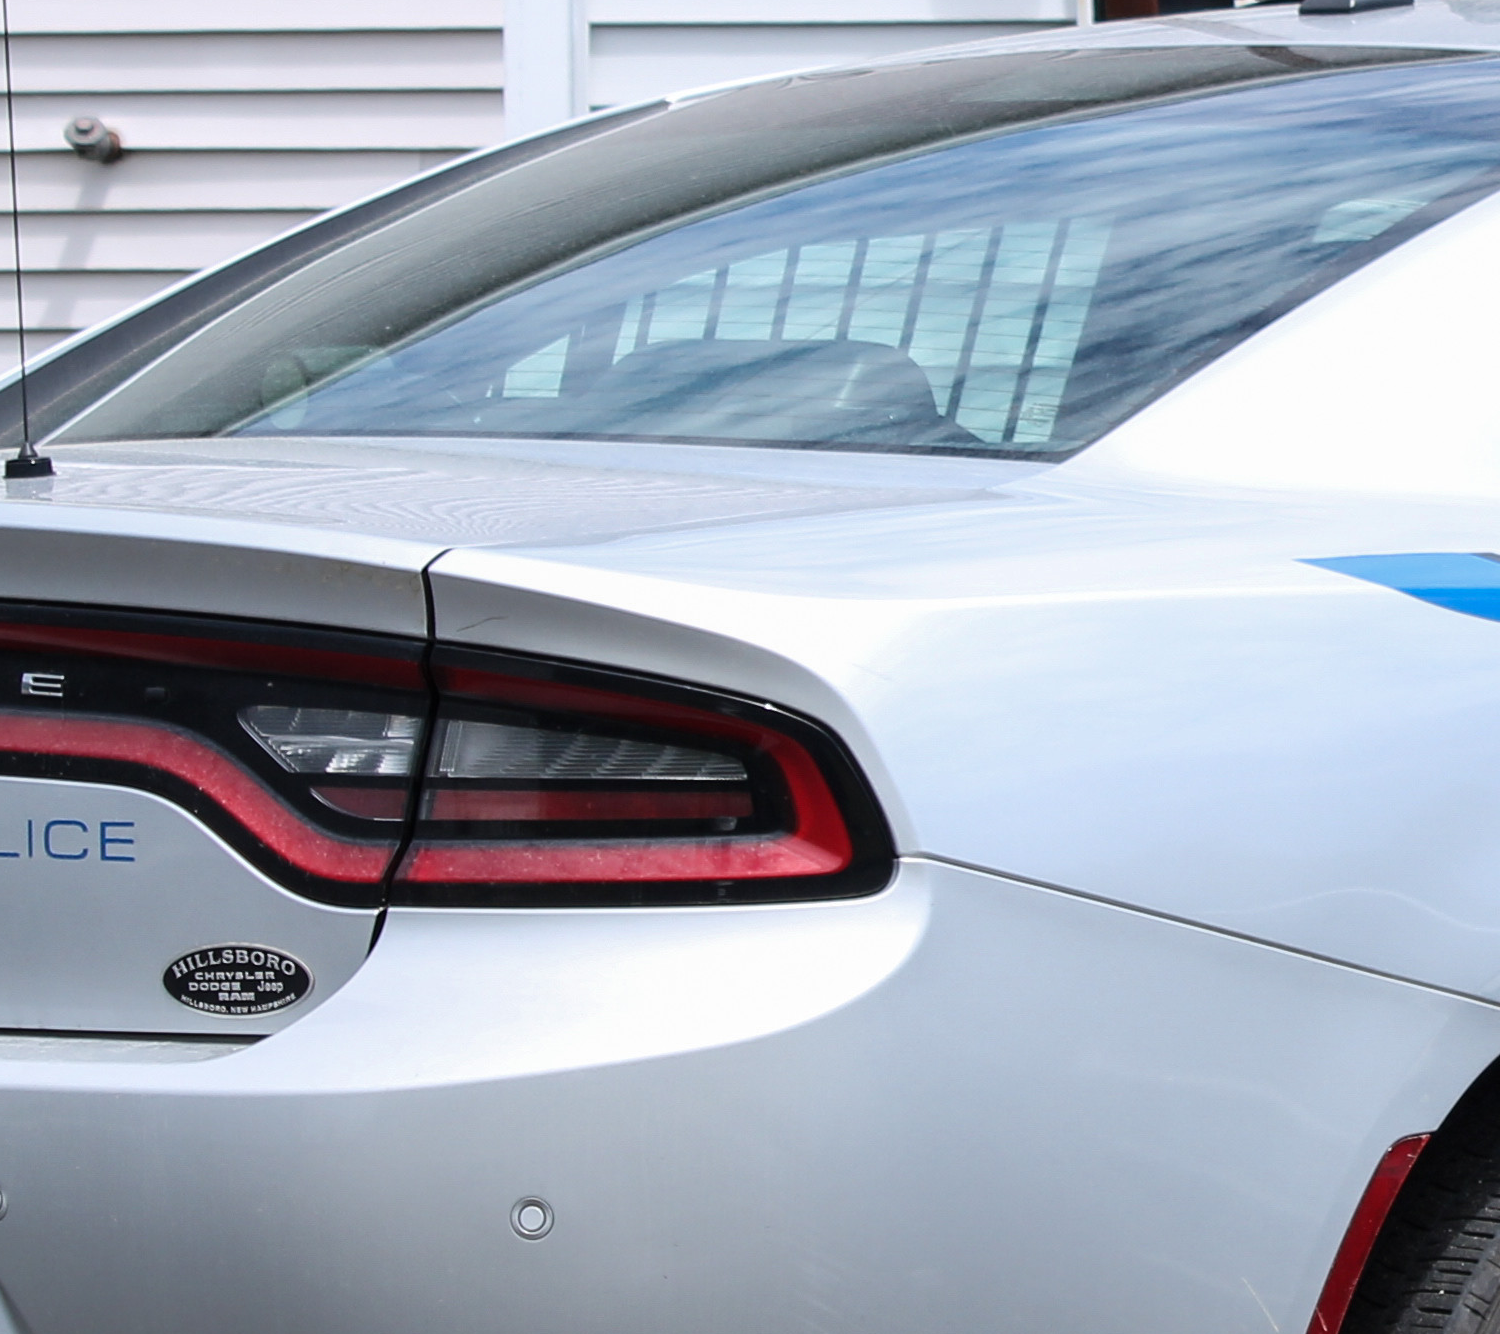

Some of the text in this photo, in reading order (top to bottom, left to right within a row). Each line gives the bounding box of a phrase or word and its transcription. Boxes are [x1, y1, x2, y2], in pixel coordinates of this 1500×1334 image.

[171, 948, 297, 979] HILLSBORO
[194, 970, 276, 981] CHRYSLER
[187, 980, 284, 994] DODGE Jeep
[218, 992, 256, 1002] RAM
[230, 1005, 249, 1014] NEW
[250, 992, 297, 1014] HAMPSHIRE
